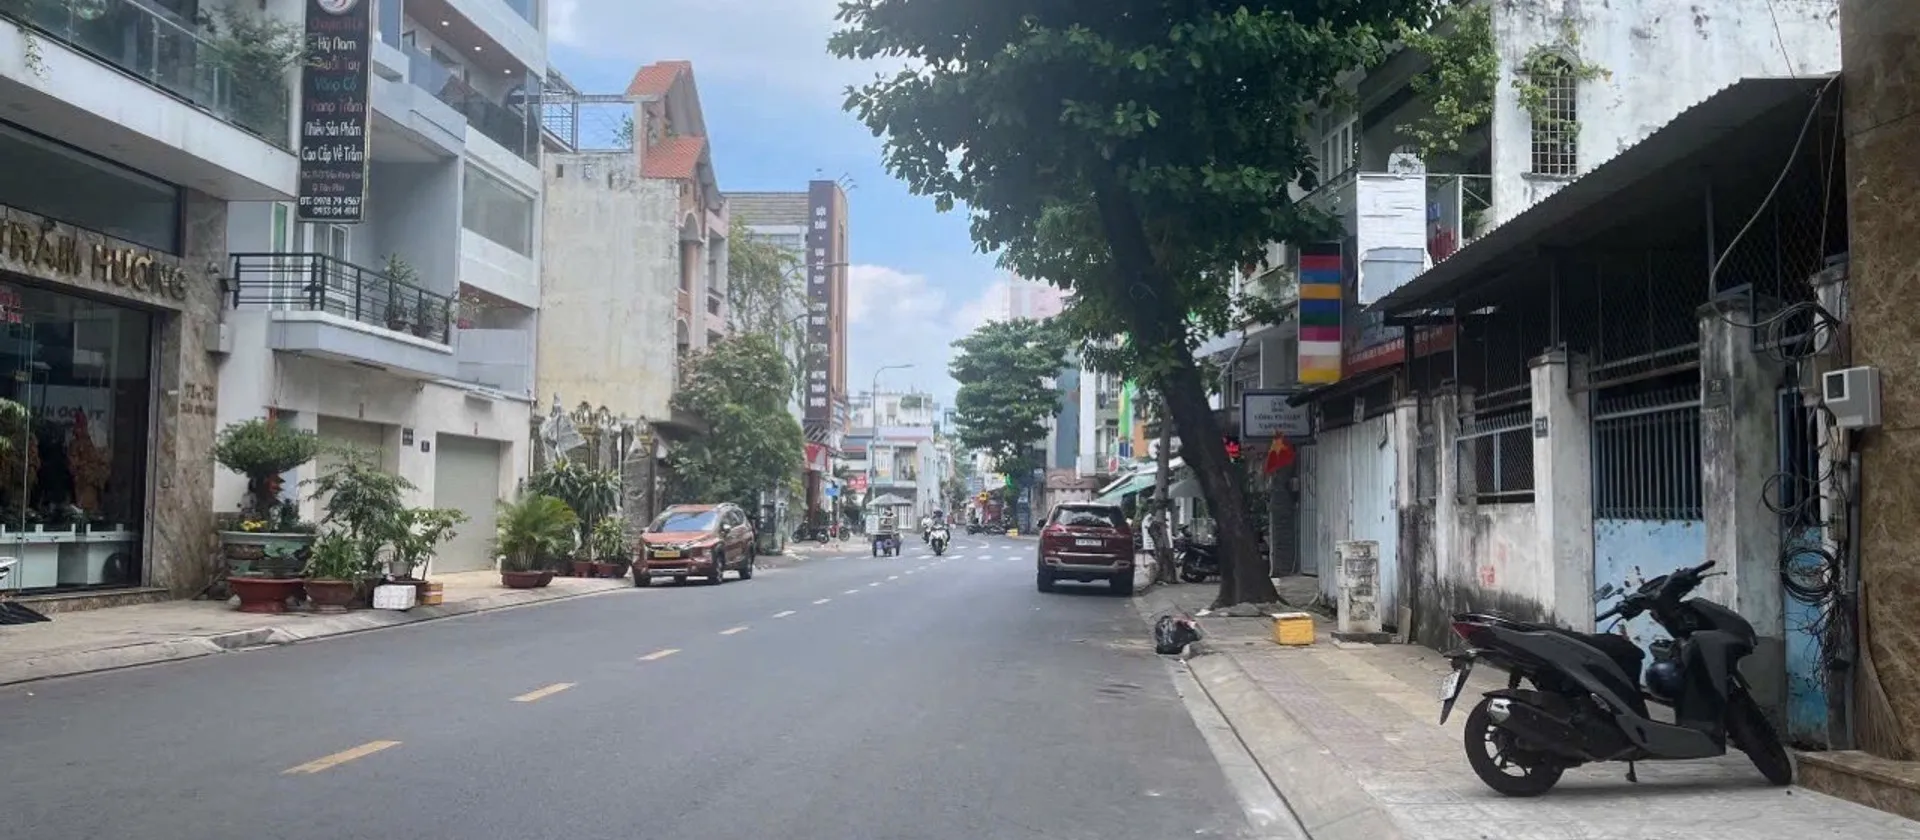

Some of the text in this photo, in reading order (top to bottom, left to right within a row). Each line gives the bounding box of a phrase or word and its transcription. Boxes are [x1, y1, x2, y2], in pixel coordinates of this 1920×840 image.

[304, 118, 362, 136] Nhiều Sản Phẩm
[301, 146, 317, 161] Cao
[318, 144, 332, 164] Cấp
[344, 144, 363, 161] Trầm
[333, 196, 341, 205] 79
[344, 196, 360, 205] 4567
[91, 243, 190, 300] HƯƠNG
